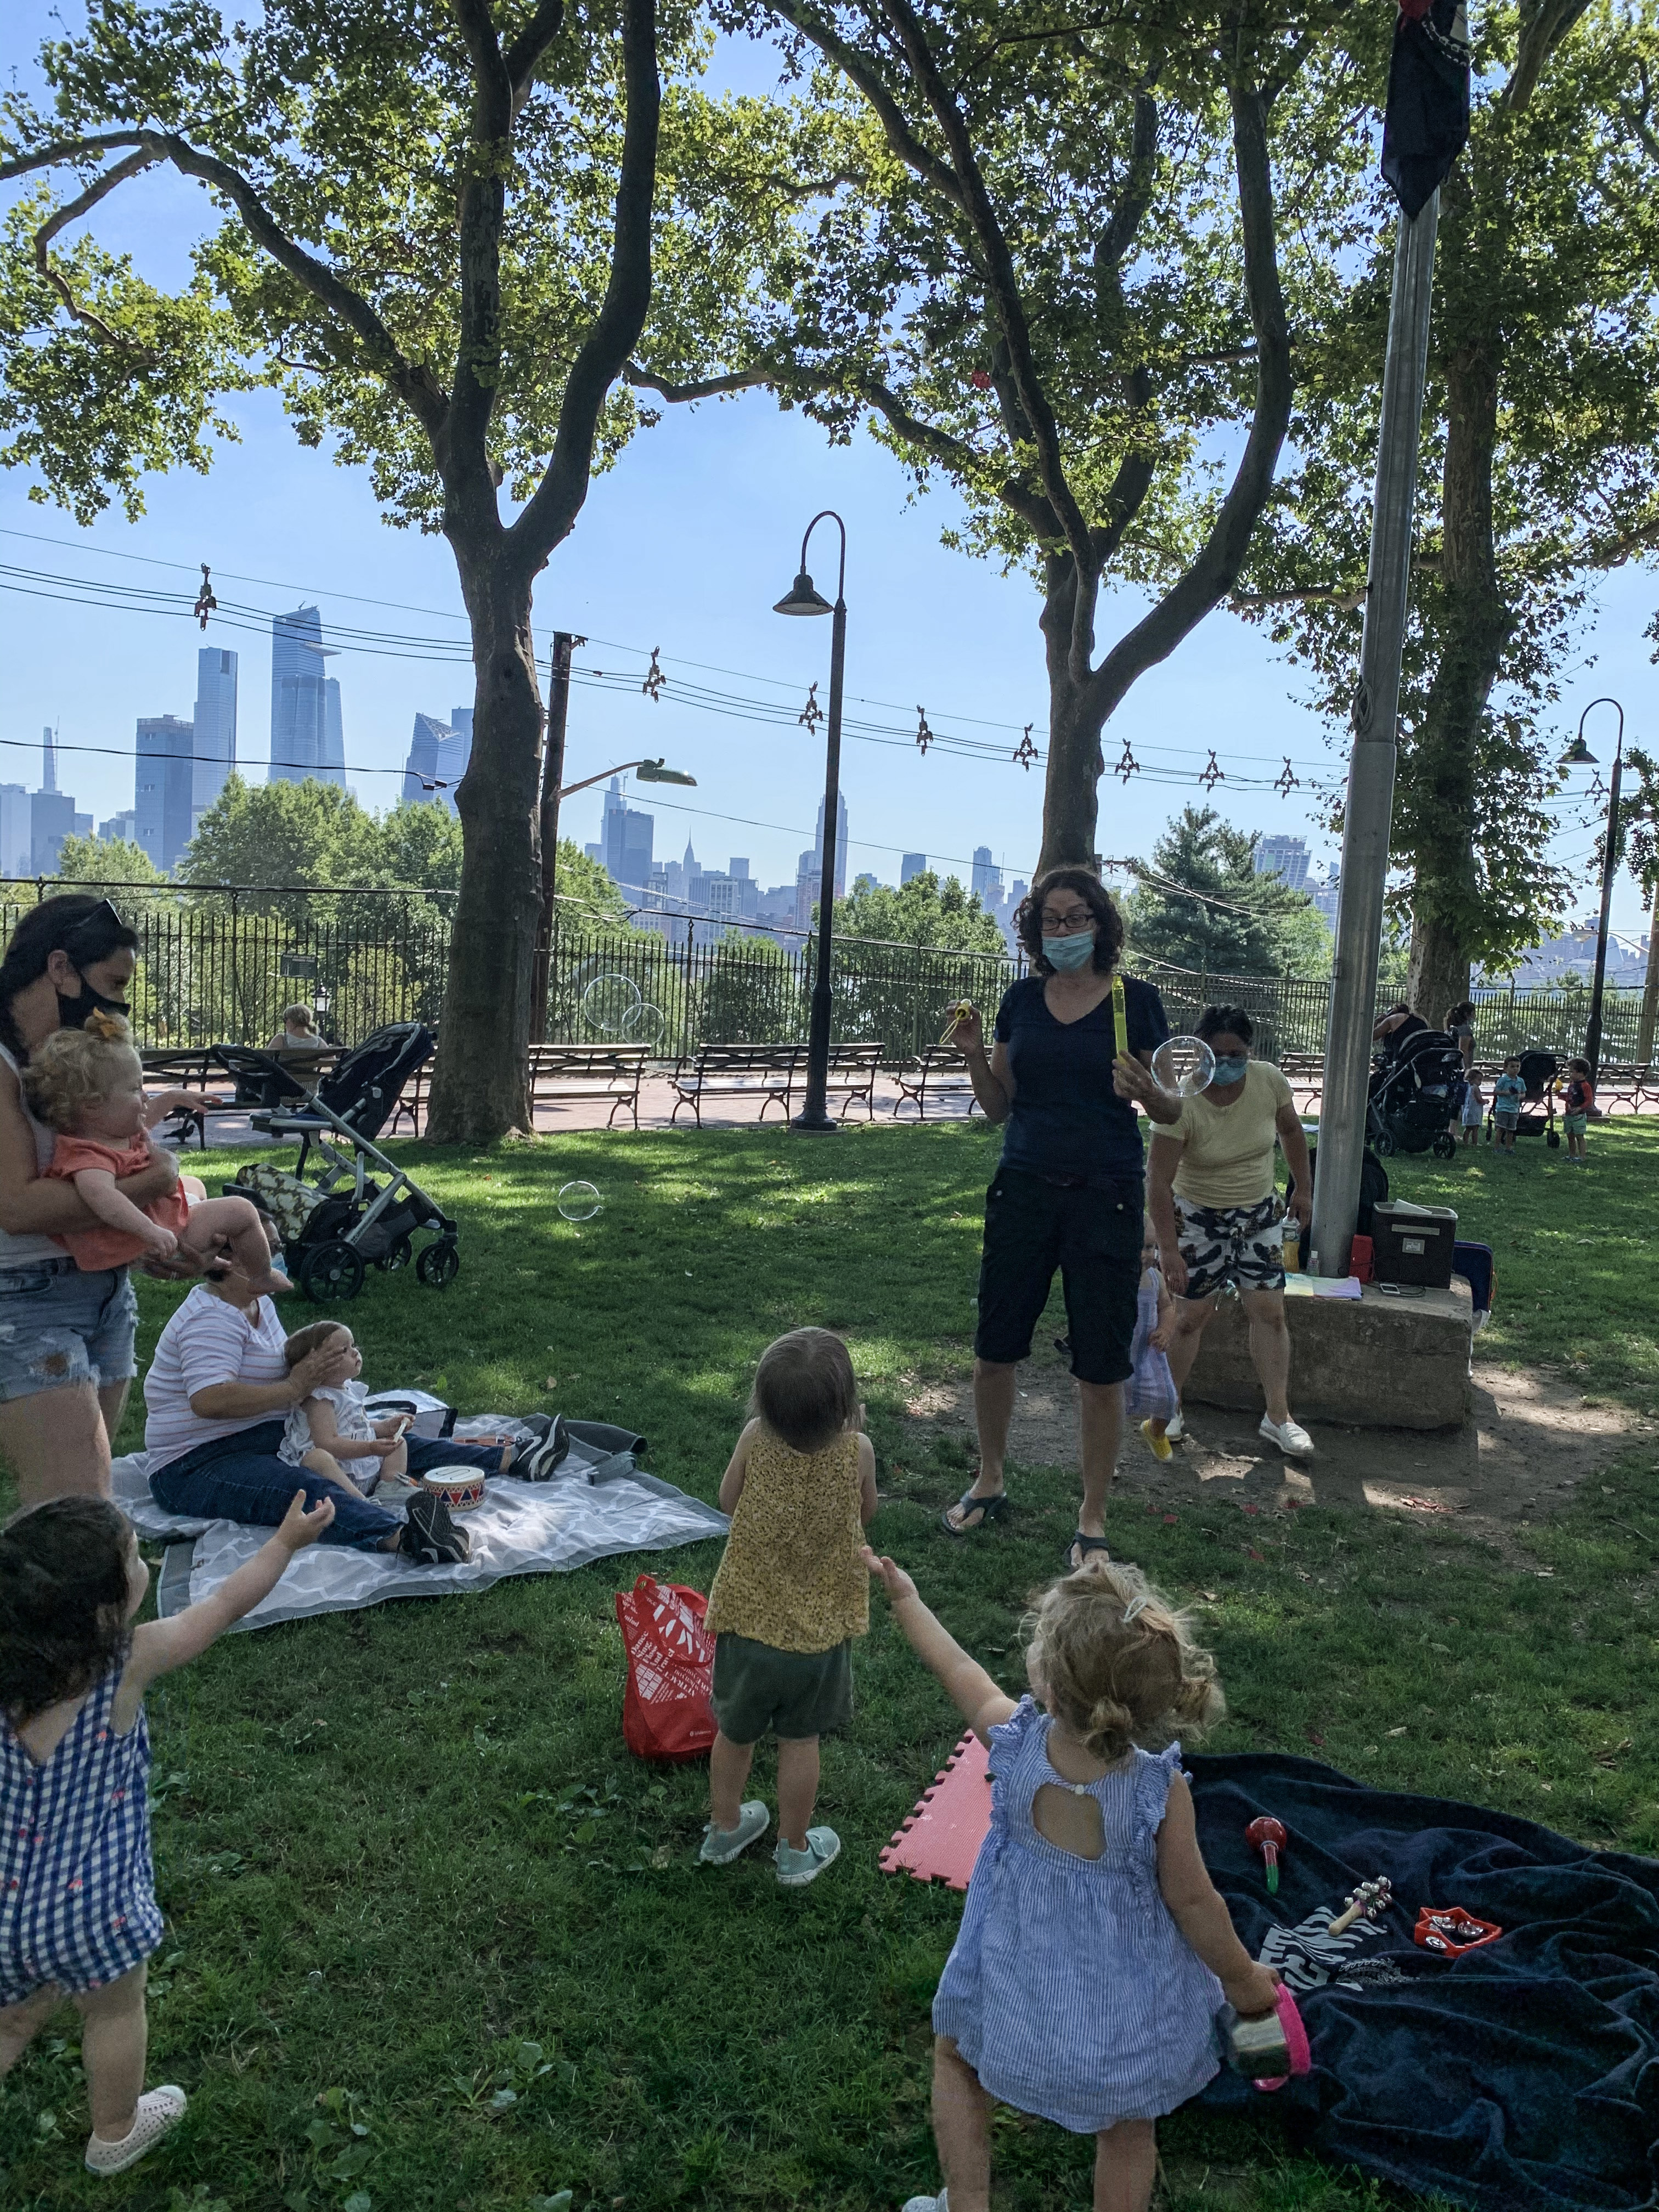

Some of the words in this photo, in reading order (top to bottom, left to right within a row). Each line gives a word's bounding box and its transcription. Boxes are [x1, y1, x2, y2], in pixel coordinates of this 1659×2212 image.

[649, 1651, 663, 1667] And
[655, 1648, 675, 1672] Travel
[664, 1671, 695, 1696] ATTRACT
